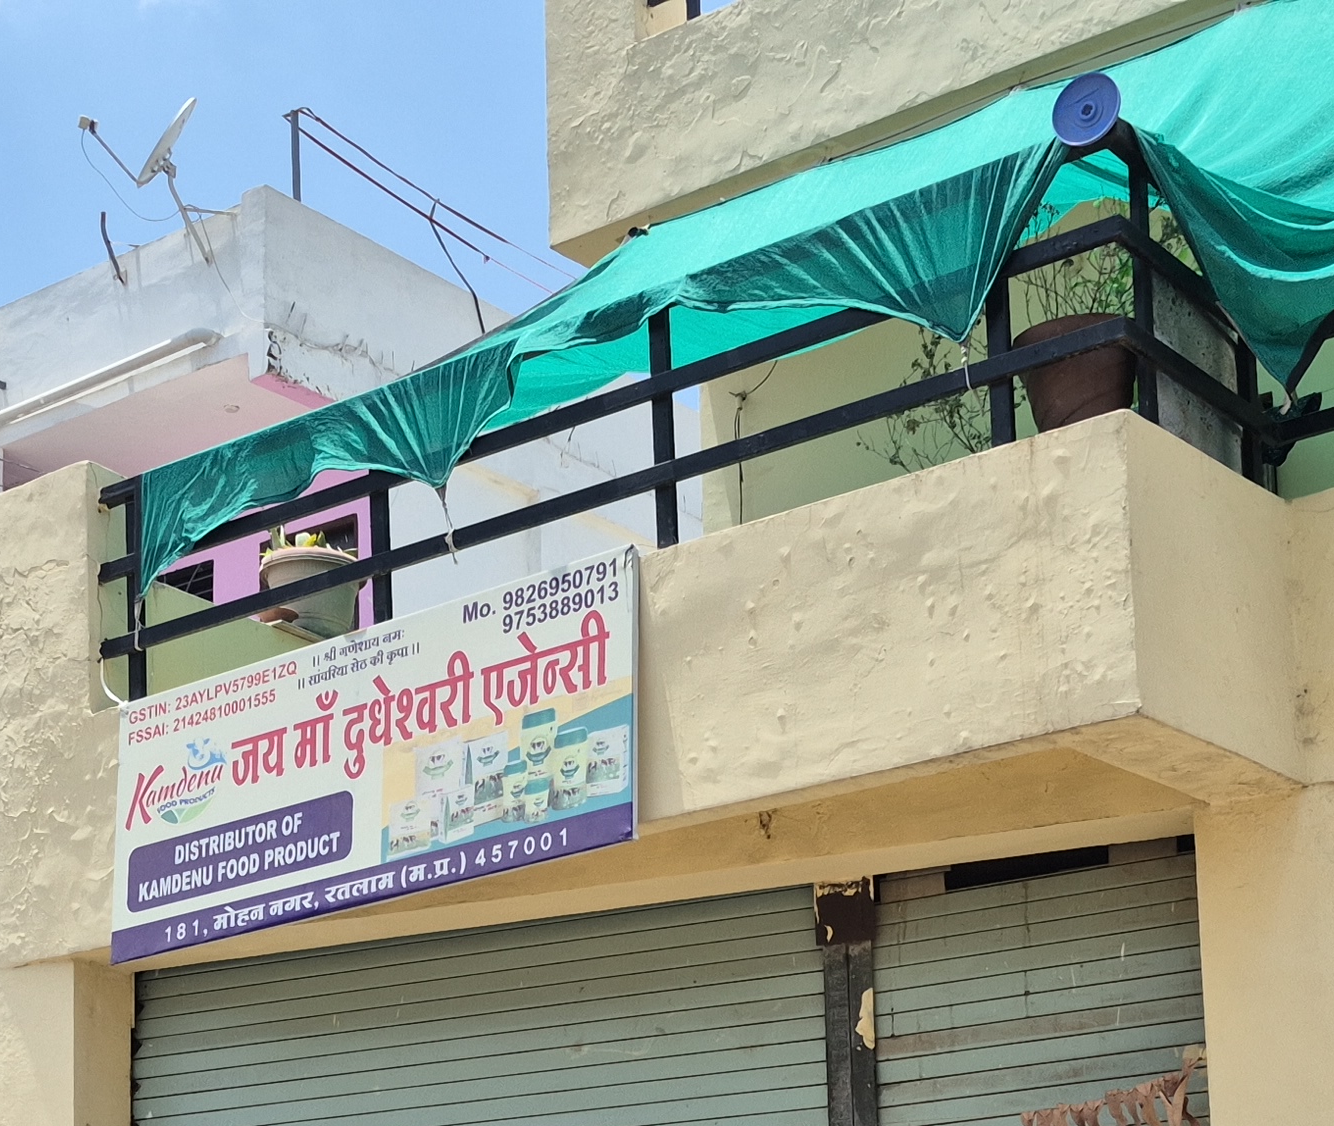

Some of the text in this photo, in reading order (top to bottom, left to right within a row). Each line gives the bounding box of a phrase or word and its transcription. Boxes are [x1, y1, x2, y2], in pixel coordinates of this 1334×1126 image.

[463, 558, 617, 624] Mo. 9826950791
[503, 581, 619, 634] 9753889013
[323, 646, 337, 662] श्री
[339, 637, 380, 658] गणेशाय
[382, 629, 405, 648] नमः
[350, 656, 367, 674] सेठ
[369, 650, 385, 668] की
[386, 645, 409, 667] कृपा
[128, 690, 276, 746] FSSAI: 21424810001555
[129, 661, 297, 725] GSTIN: 23AYLPV5799E1ZQ
[231, 609, 610, 787] जय माँ दुधेश्वरी एजेन्सी
[125, 765, 224, 831] Kamdenu
[179, 787, 216, 805] PRODUCTS
[138, 832, 341, 903] KAMDENU FOOD PRODUCT
[174, 812, 303, 865] DISTRIBUTOR OF
[213, 900, 265, 931] मोहन
[269, 890, 319, 918] नगर,
[325, 869, 396, 903] रतलाम
[475, 828, 568, 867] 457001
